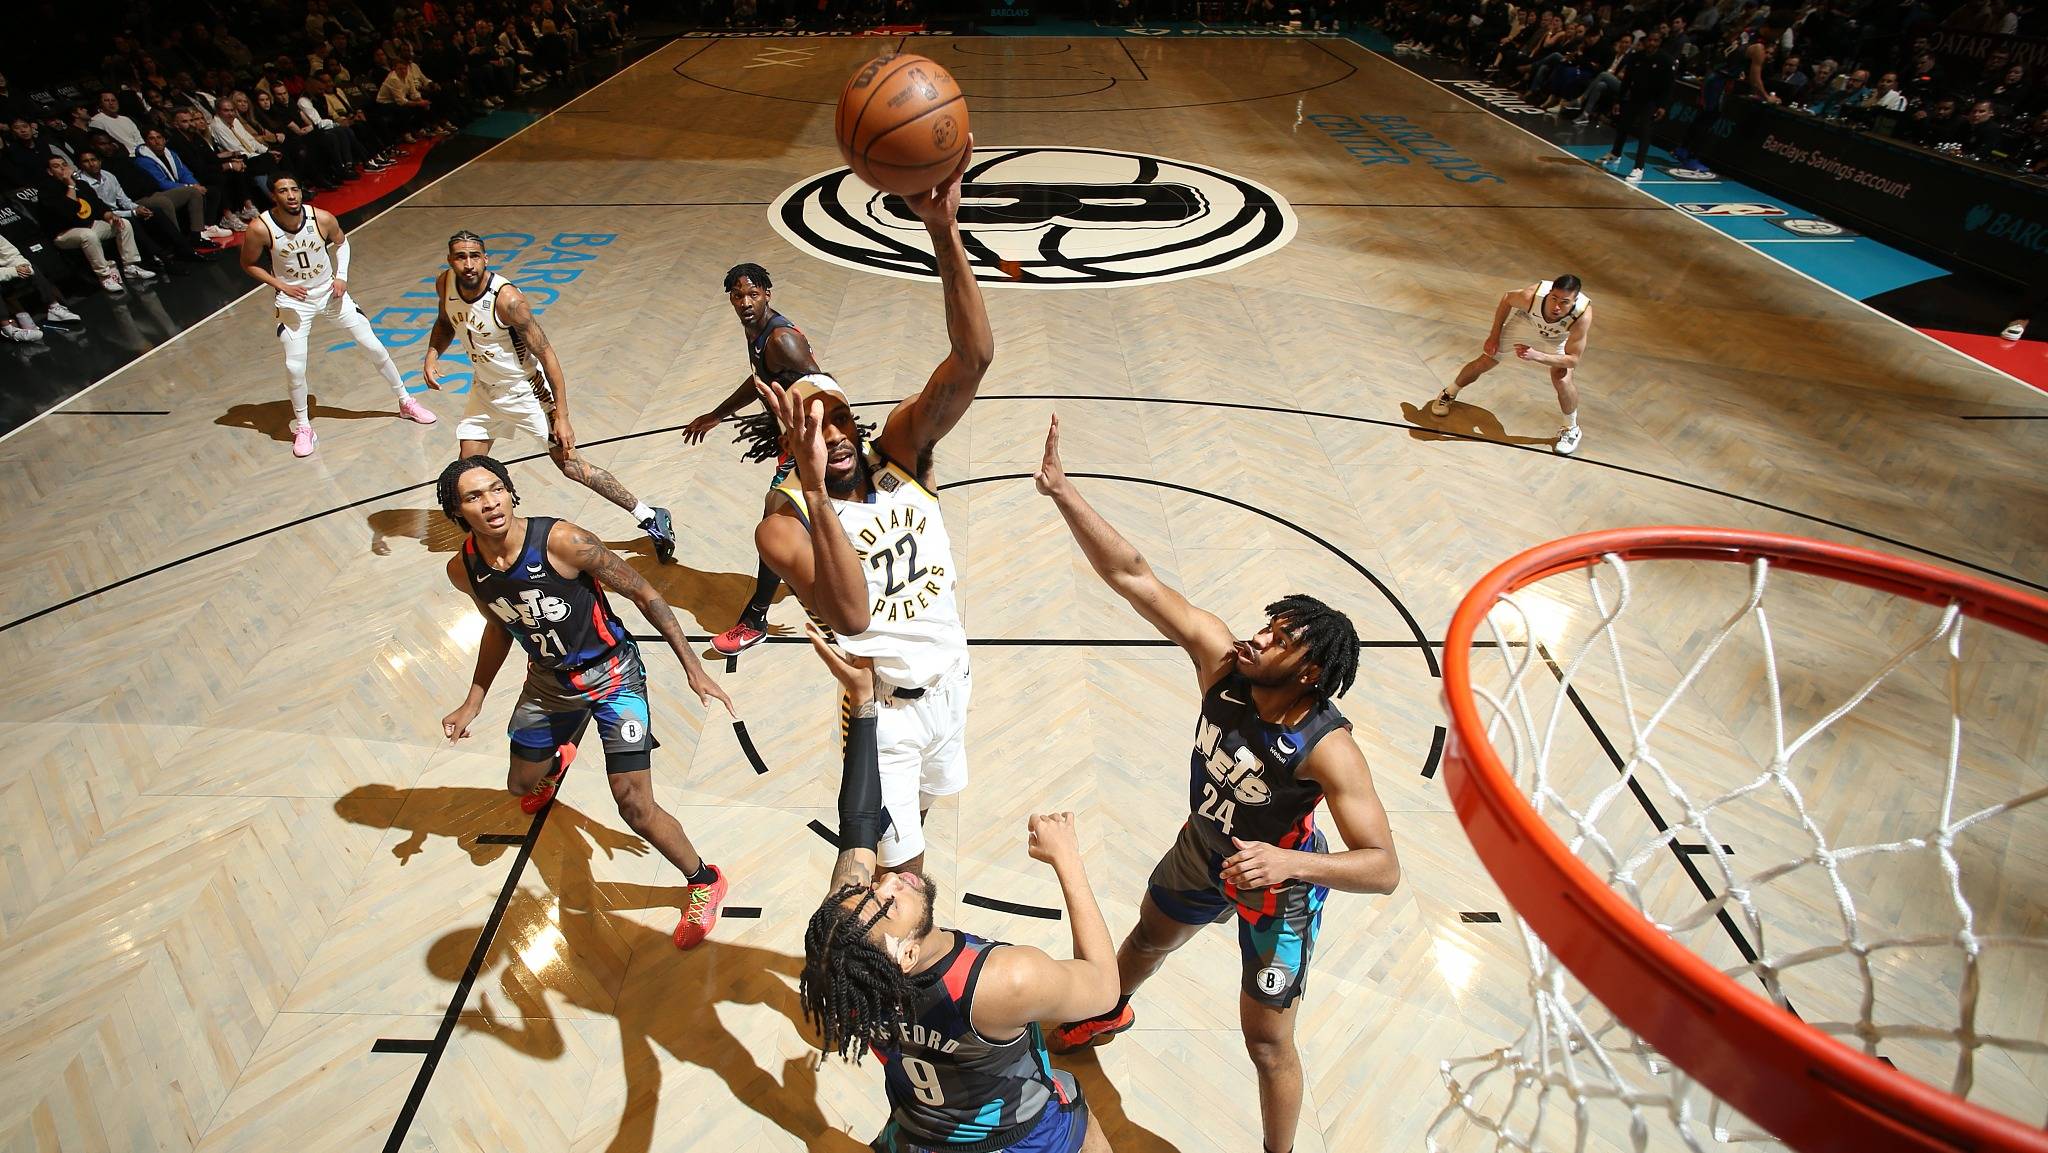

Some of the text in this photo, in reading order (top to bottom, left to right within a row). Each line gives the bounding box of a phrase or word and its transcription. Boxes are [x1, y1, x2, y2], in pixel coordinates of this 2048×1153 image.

[990, 8, 1031, 17] BARCLAYS
[1306, 113, 1411, 167] CENTER
[1359, 114, 1506, 184] BARCLAYS
[1761, 134, 1913, 199] Barclays Savings account
[279, 239, 322, 259] INDIANA
[286, 263, 324, 280] PACERS
[296, 251, 311, 269] 0
[451, 311, 491, 338] INDIANA
[855, 507, 927, 561] NDIANA
[870, 532, 928, 597] 22
[487, 588, 572, 630] NETS
[871, 565, 945, 622] PACERS
[530, 628, 568, 658] 21
[1195, 714, 1273, 807] NETS
[1269, 745, 1288, 766] Webull
[1197, 782, 1237, 836] 24
[901, 1056, 946, 1107] 9
